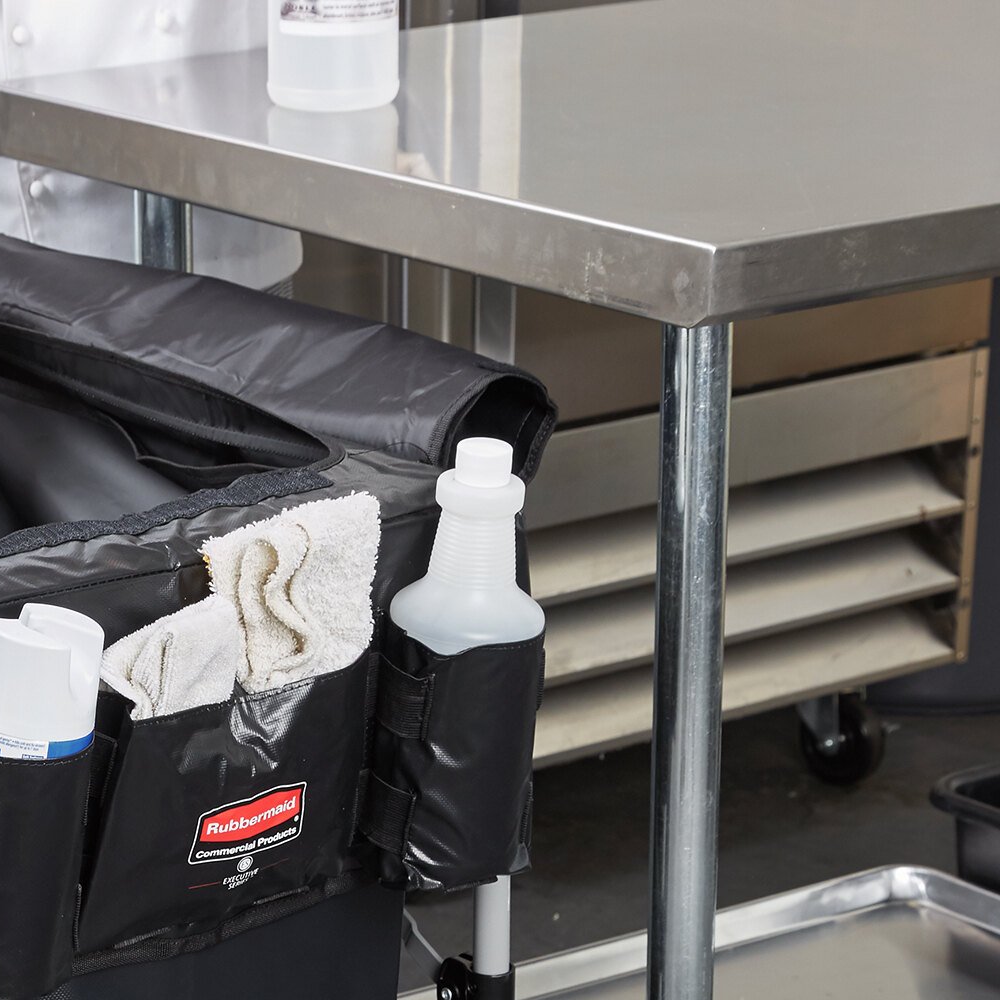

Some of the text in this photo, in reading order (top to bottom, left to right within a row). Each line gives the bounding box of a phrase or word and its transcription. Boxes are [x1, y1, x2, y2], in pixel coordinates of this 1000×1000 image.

[206, 796, 297, 835] Rubbermaid
[195, 827, 297, 859] Commercial Products
